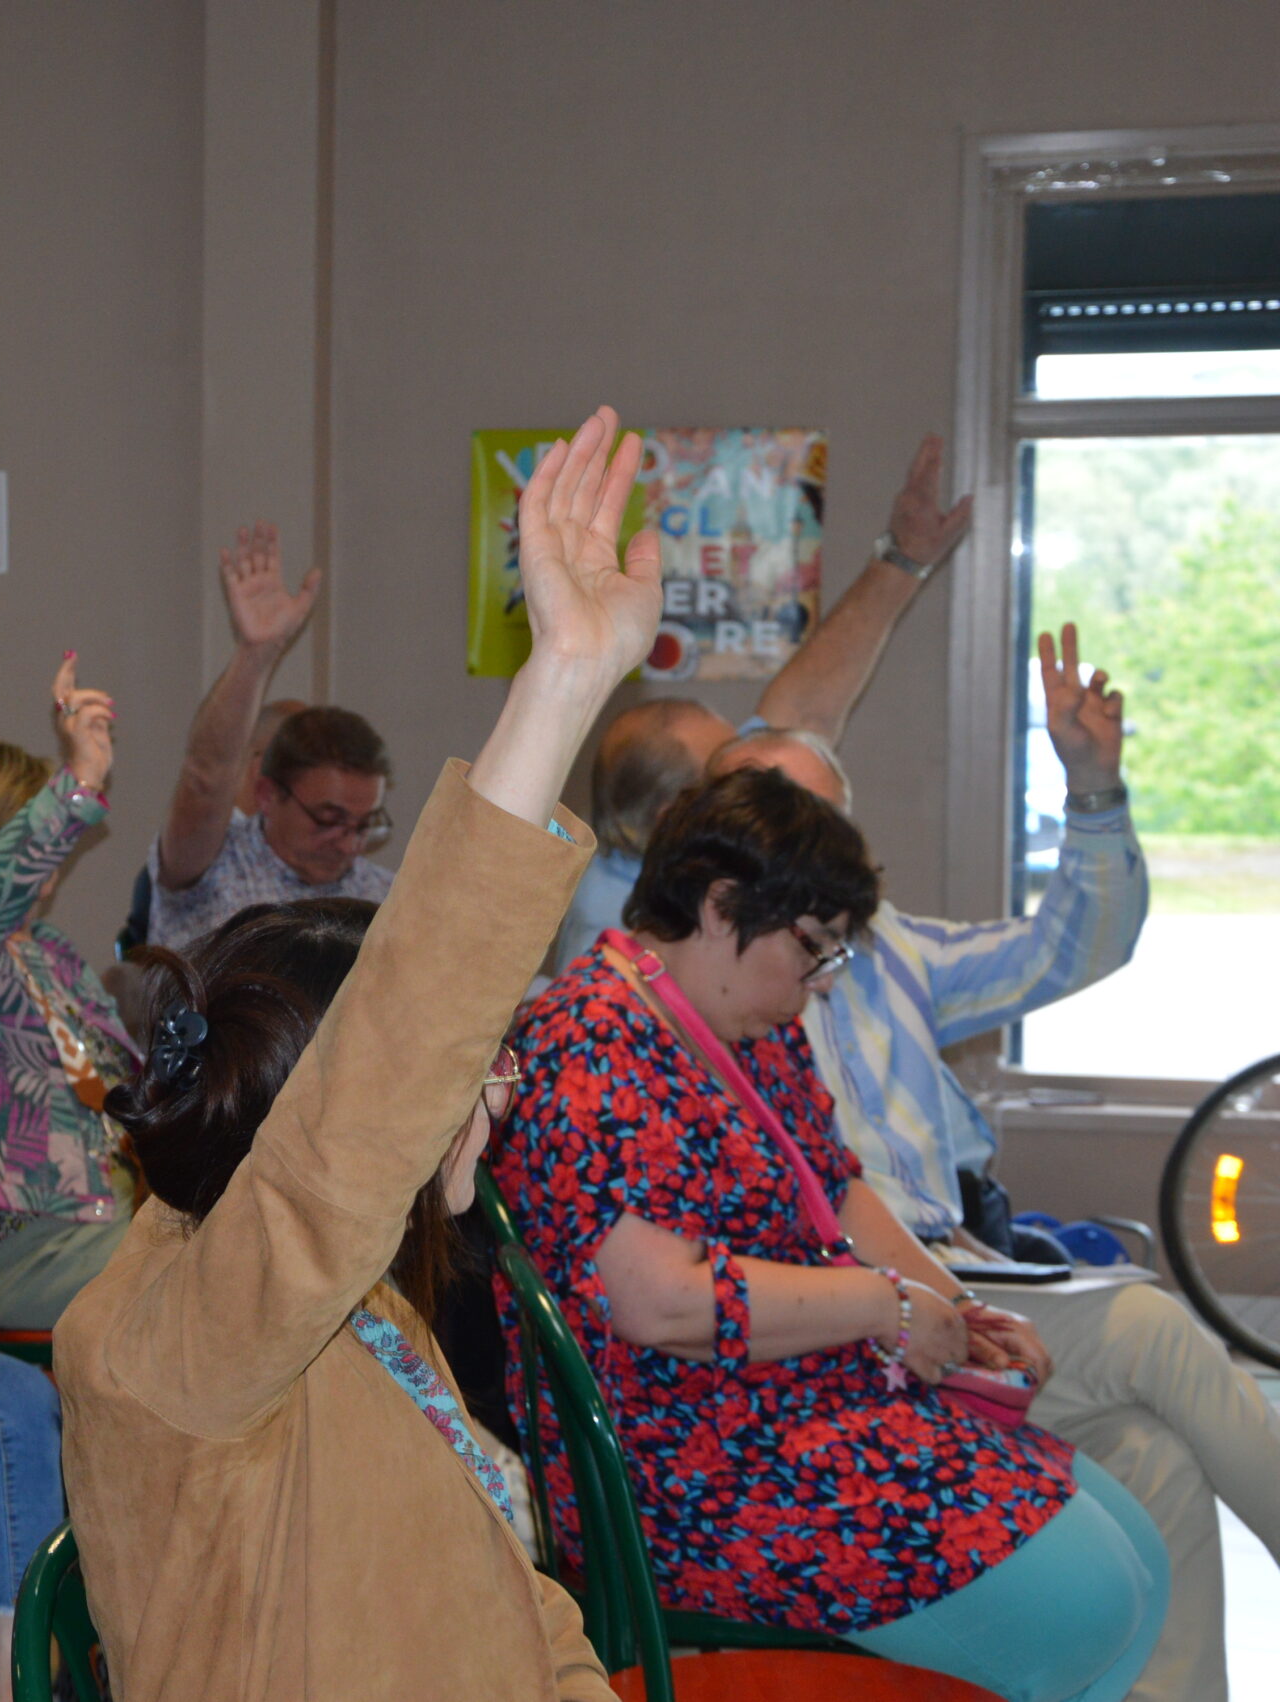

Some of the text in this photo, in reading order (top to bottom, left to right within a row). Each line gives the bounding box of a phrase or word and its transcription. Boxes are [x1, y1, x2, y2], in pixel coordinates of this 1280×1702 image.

[660, 505, 721, 536] GL
[701, 545, 757, 575] ET
[665, 582, 730, 615] ER
[714, 620, 781, 655] RE
